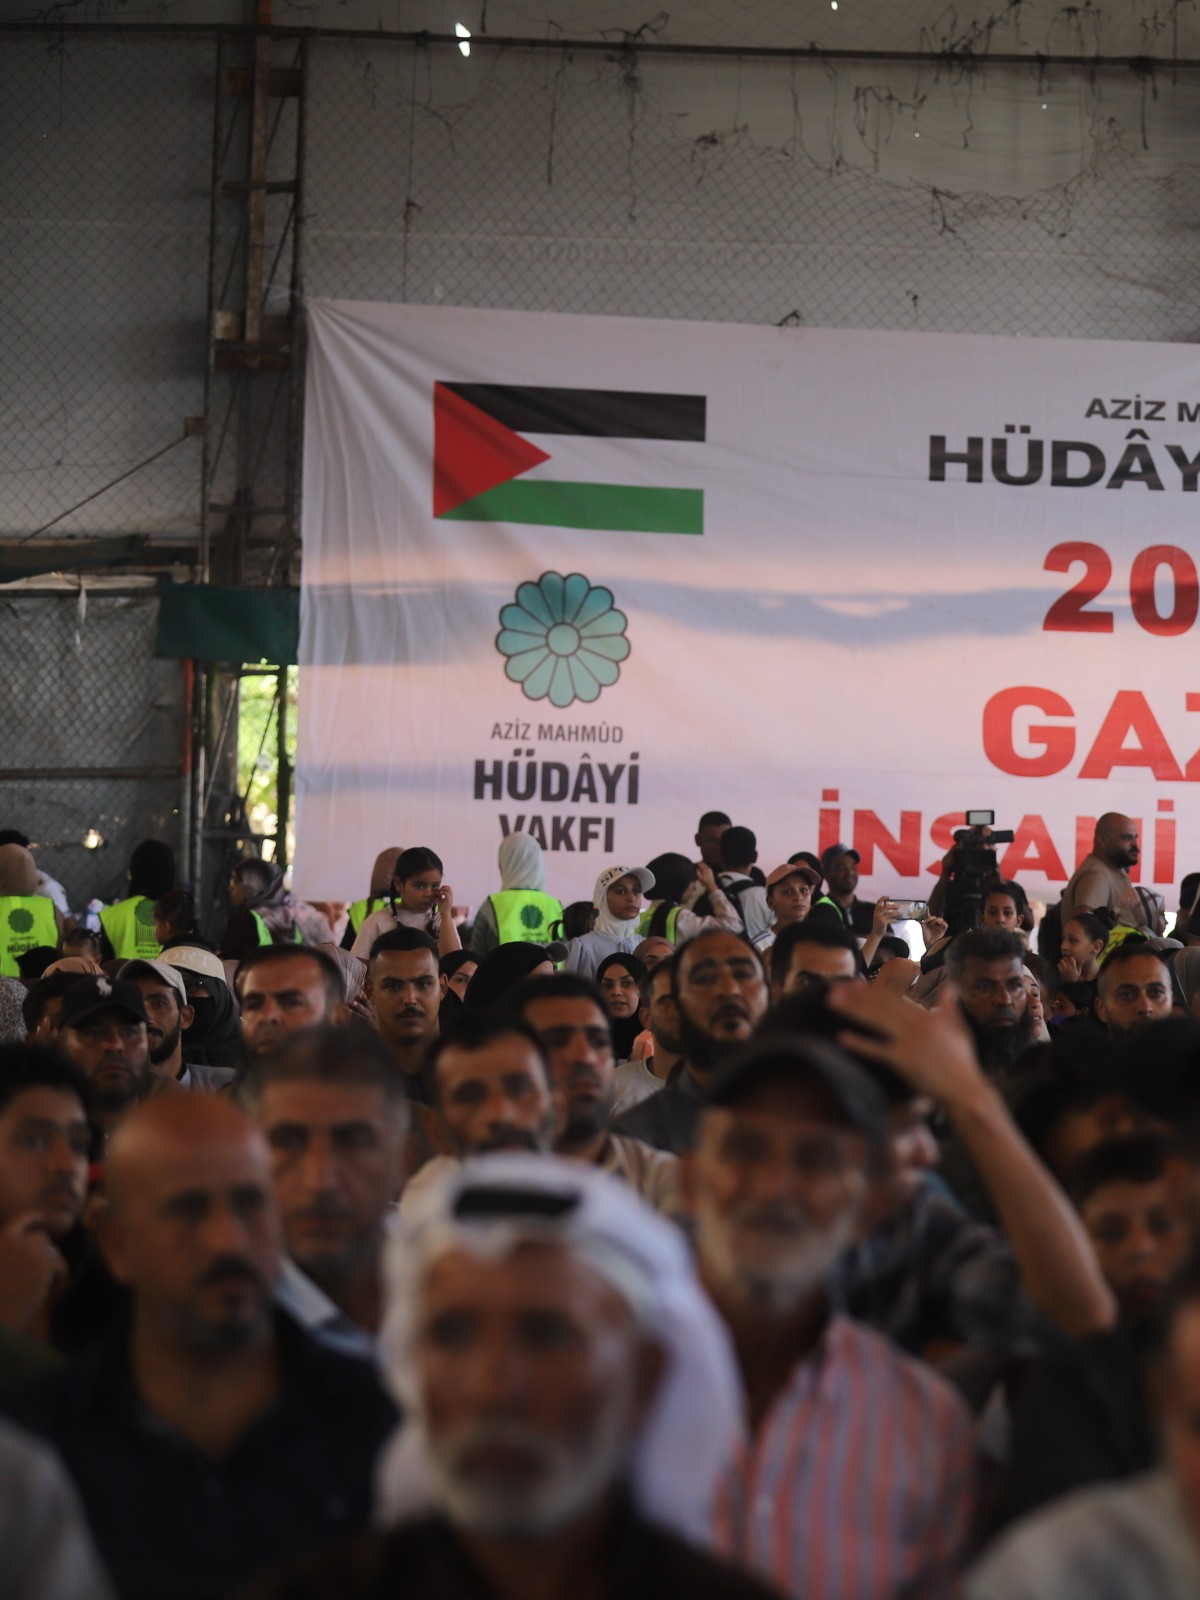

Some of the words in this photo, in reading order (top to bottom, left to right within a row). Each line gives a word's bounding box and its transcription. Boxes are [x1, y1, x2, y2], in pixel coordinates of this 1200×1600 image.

[1085, 394, 1166, 421] AZİZ
[491, 718, 531, 740] AZİZ
[538, 721, 623, 743] MAHMÛD
[474, 748, 640, 804] HÜDÂYİ
